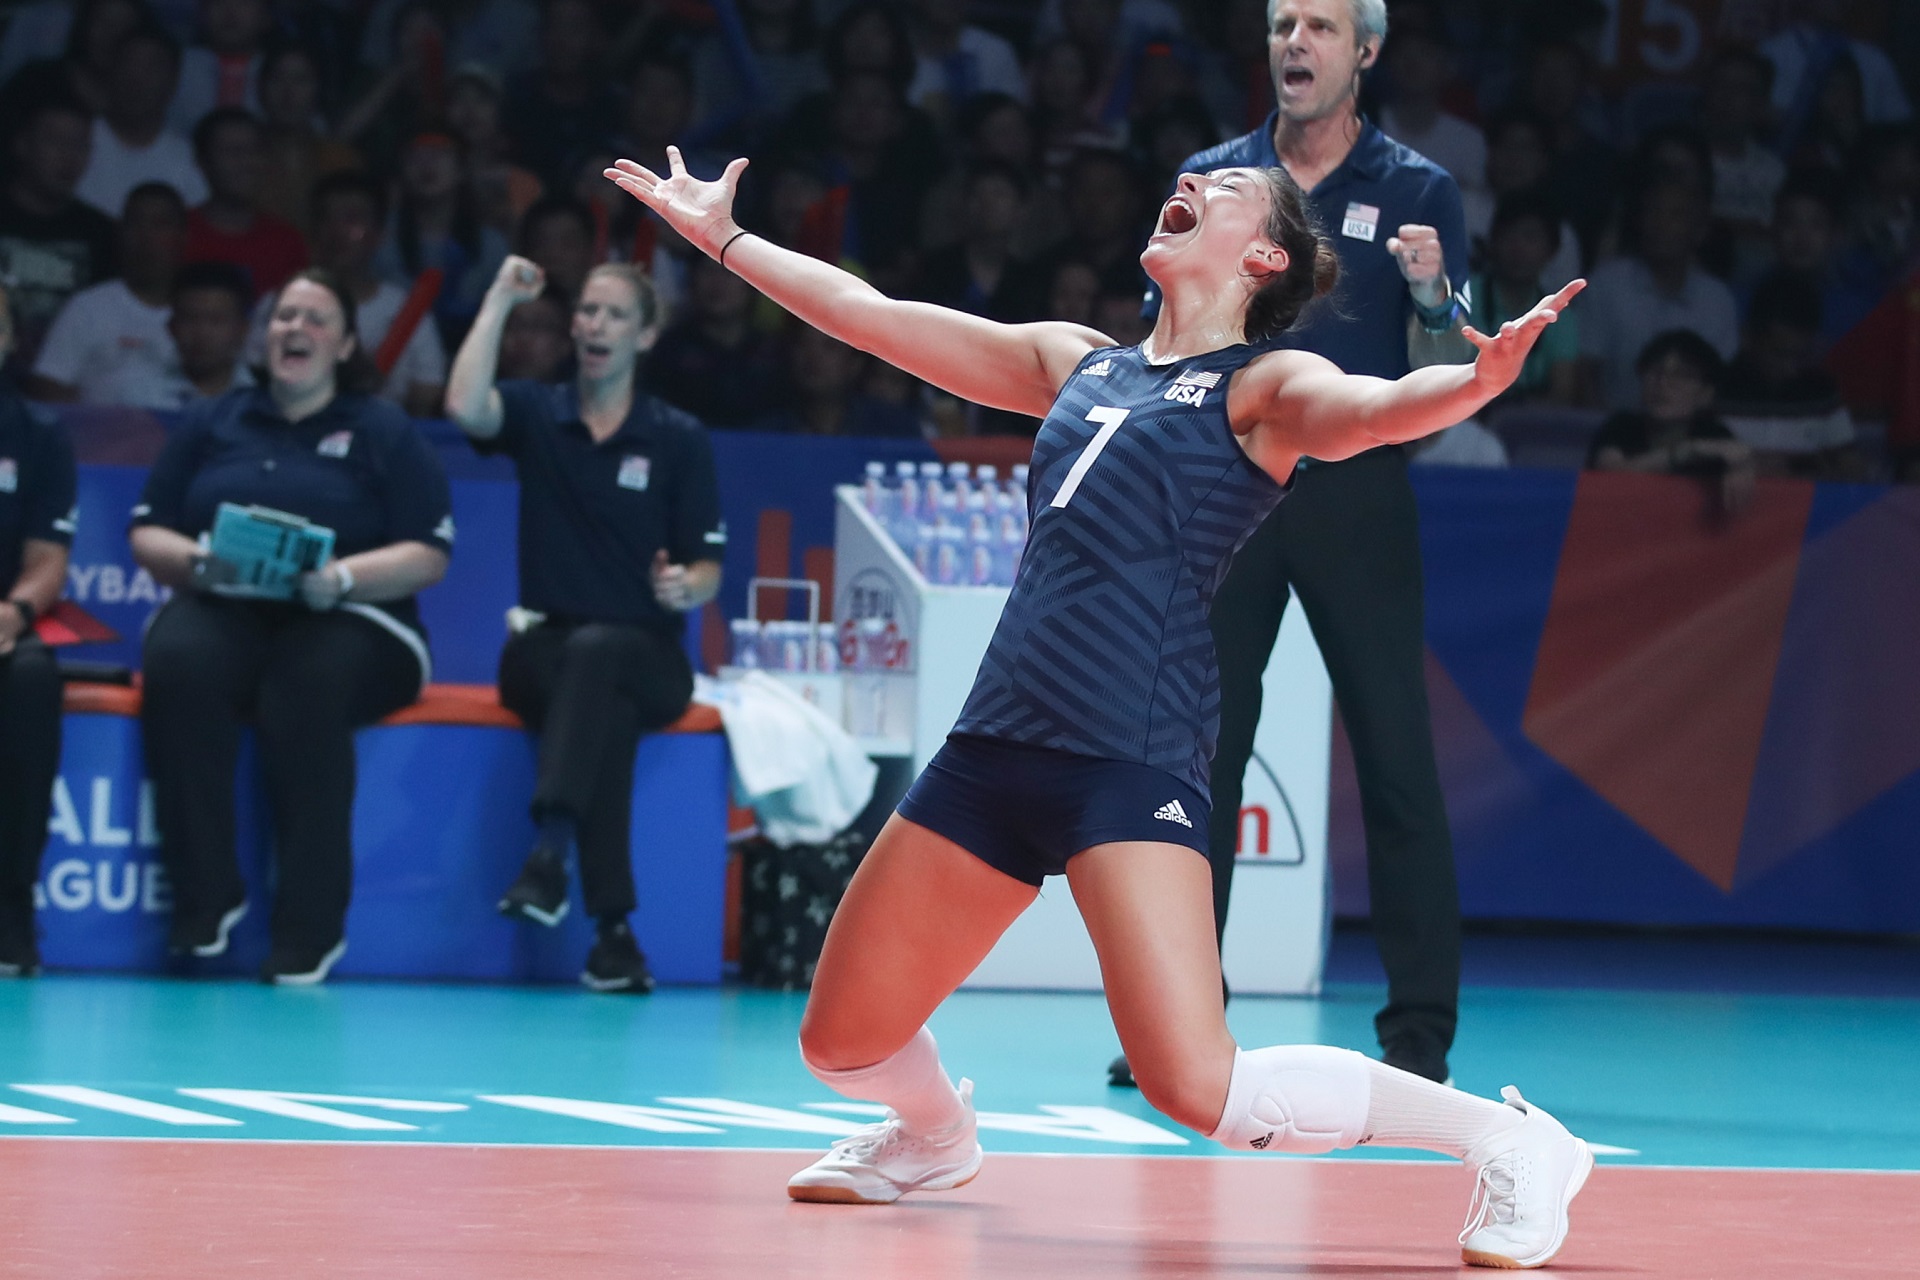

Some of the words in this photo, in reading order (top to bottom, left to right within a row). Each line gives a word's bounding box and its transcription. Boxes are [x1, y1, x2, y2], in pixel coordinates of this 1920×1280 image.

[1599, 0, 1699, 73] 15
[1347, 222, 1370, 237] USA
[1164, 384, 1207, 408] USA
[1050, 405, 1131, 509] 7
[66, 564, 172, 603] YBA
[1153, 810, 1193, 829] adidas
[33, 860, 173, 912] GUE
